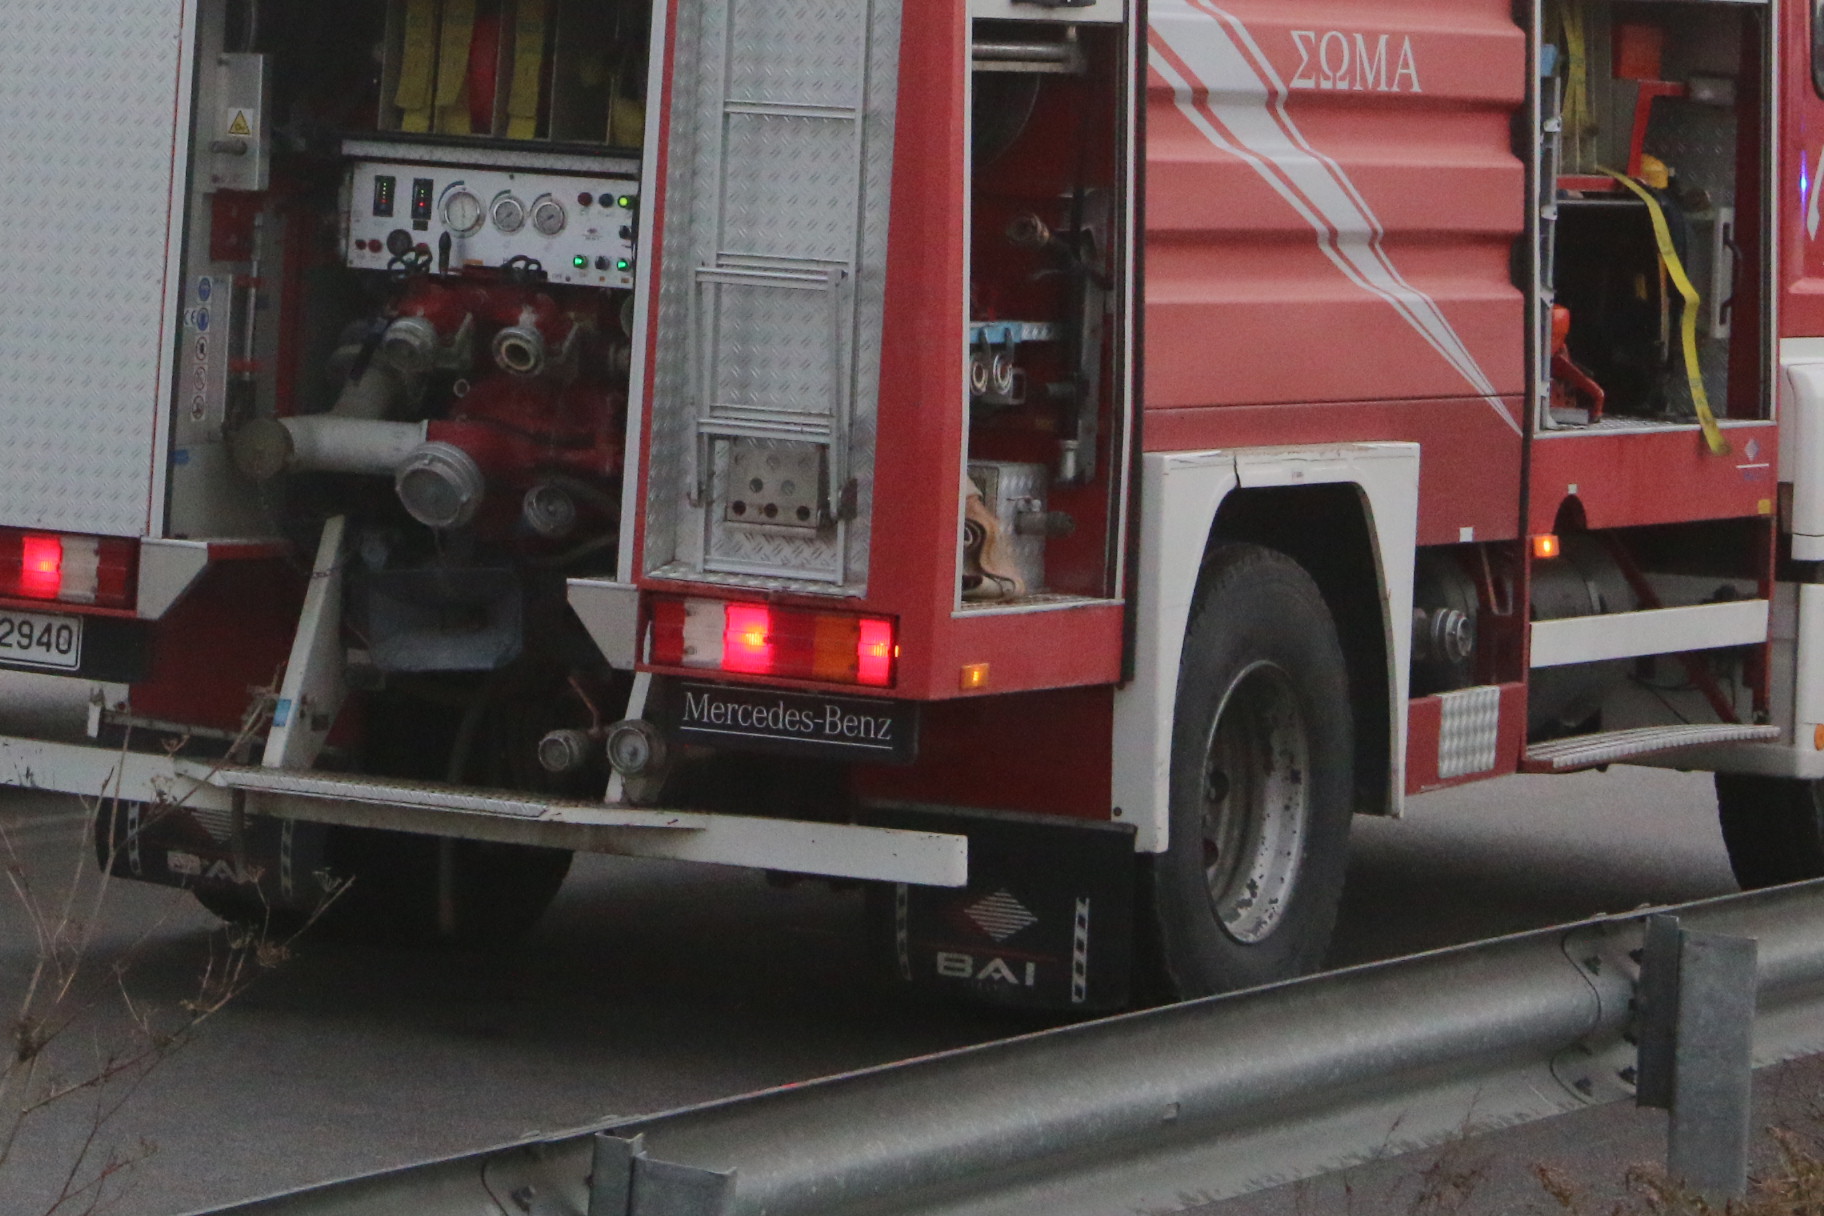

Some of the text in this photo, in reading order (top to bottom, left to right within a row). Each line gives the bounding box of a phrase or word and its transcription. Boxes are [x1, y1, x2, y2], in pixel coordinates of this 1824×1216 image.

[1289, 30, 1423, 93] ΣΩΜΑ
[682, 691, 893, 741] Mercedes-Benz
[936, 951, 1036, 987] BAI
